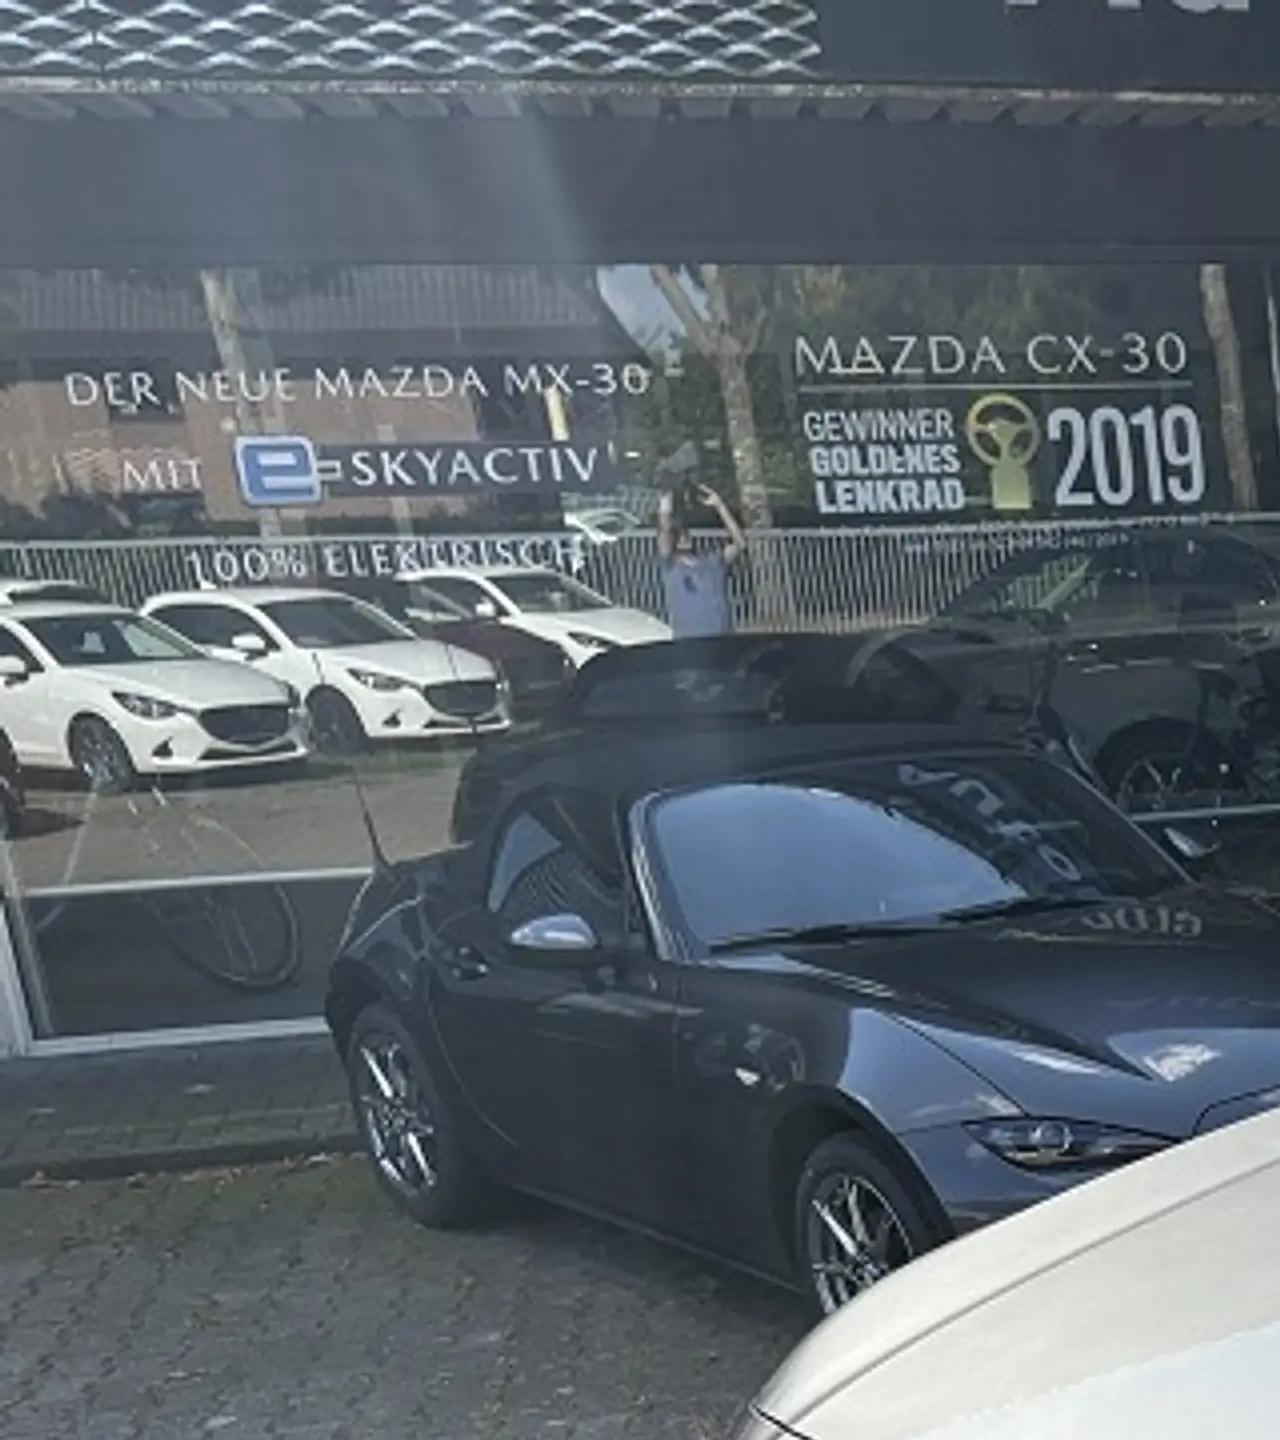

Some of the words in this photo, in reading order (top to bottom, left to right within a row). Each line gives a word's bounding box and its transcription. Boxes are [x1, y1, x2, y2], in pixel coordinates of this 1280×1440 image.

[795, 335, 1006, 375] MAZDA
[1026, 331, 1188, 374] CX-30
[66, 372, 160, 408] DER
[178, 367, 292, 403] NEUE
[314, 365, 489, 400] MAZDA
[503, 363, 651, 395] MX-30
[803, 408, 955, 442] GEWINNER
[810, 443, 962, 477] GOLDENES
[1047, 404, 1206, 506] 2019
[123, 458, 202, 493] MIT
[815, 477, 967, 514] LENKRAD
[184, 548, 307, 582] 100%
